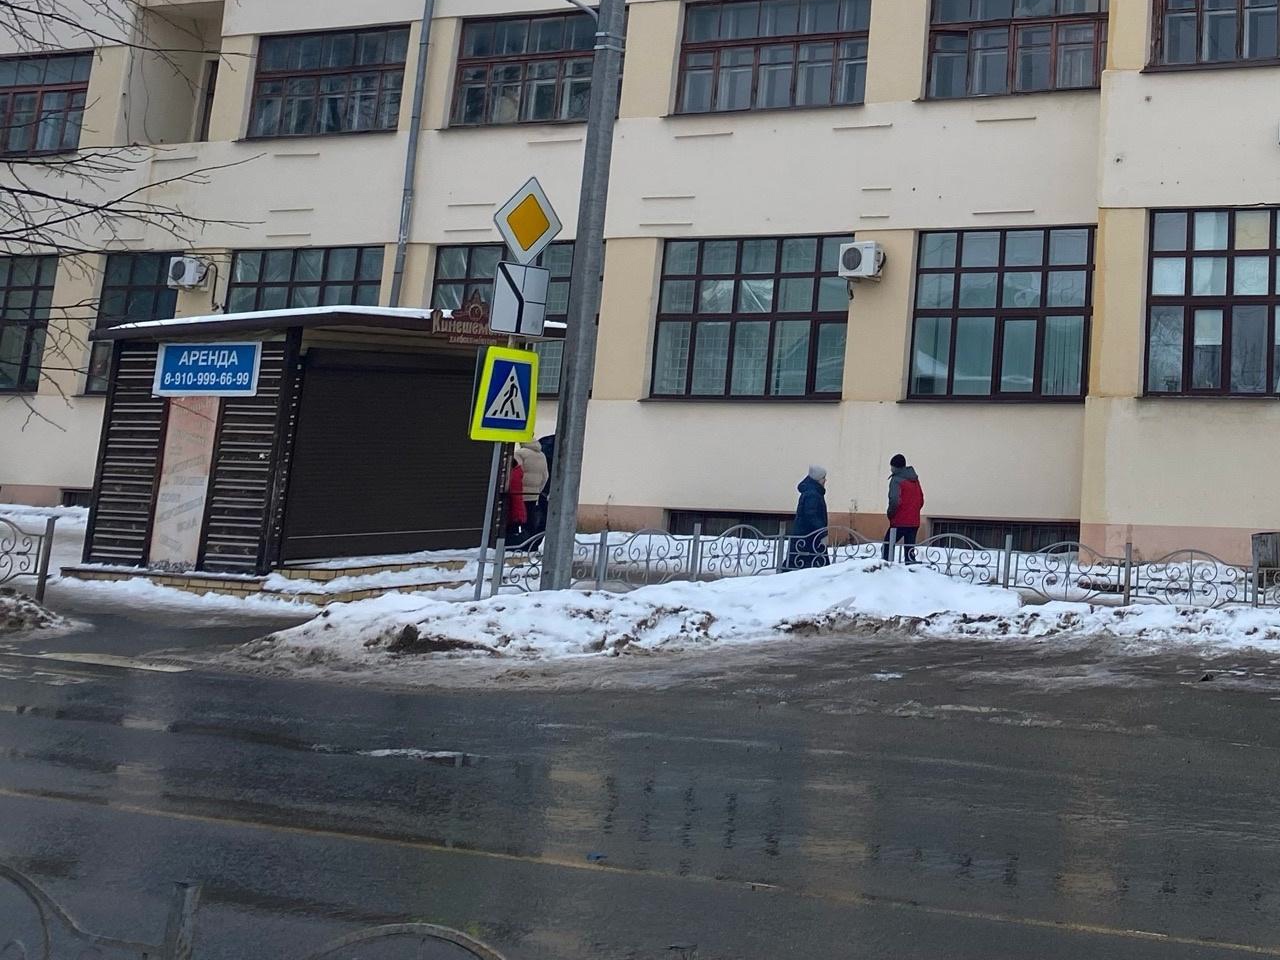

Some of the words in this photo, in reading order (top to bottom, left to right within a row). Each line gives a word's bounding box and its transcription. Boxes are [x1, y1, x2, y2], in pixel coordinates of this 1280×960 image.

[431, 309, 496, 335] Кинешем
[179, 350, 239, 368] АРЕНДА
[164, 372, 250, 385] 8-910-999-66-99
